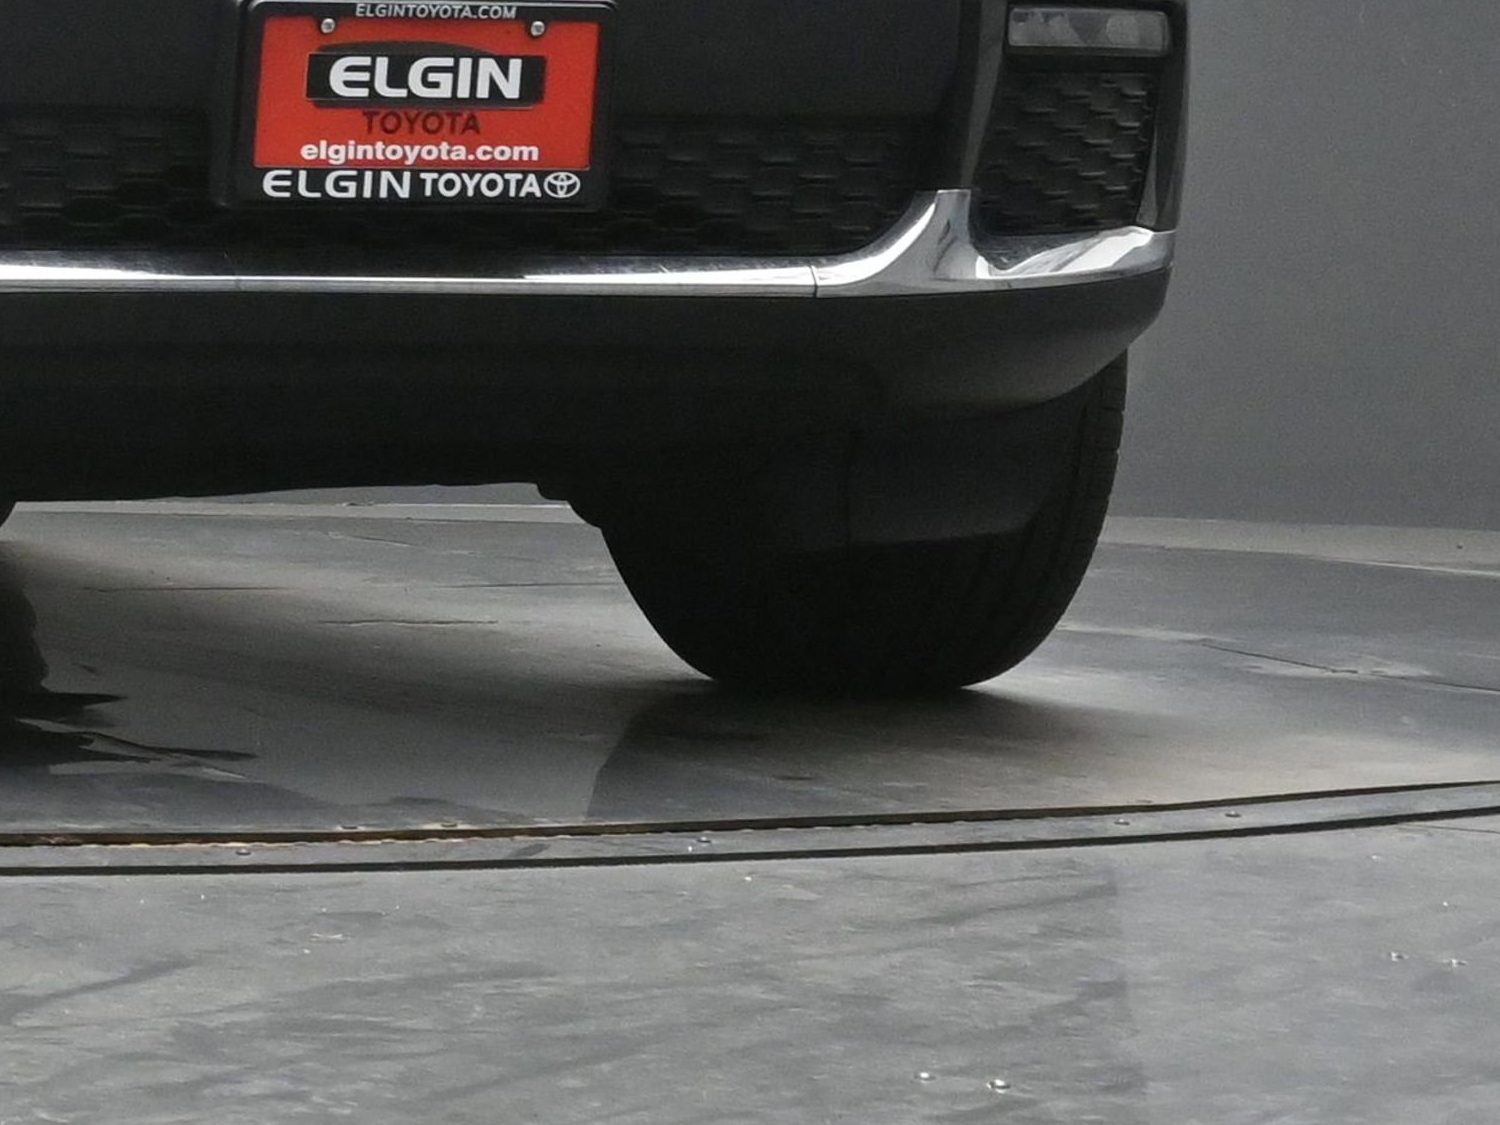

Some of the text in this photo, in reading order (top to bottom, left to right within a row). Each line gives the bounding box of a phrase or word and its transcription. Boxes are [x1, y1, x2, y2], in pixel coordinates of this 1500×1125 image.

[355, 3, 517, 20] ELGINTOYOTA.COM
[329, 56, 522, 100] ELGIN
[362, 111, 481, 135] TOYOTA
[300, 140, 539, 165] elgintoyota.com
[263, 169, 542, 198] ELGIN TOYOTA
